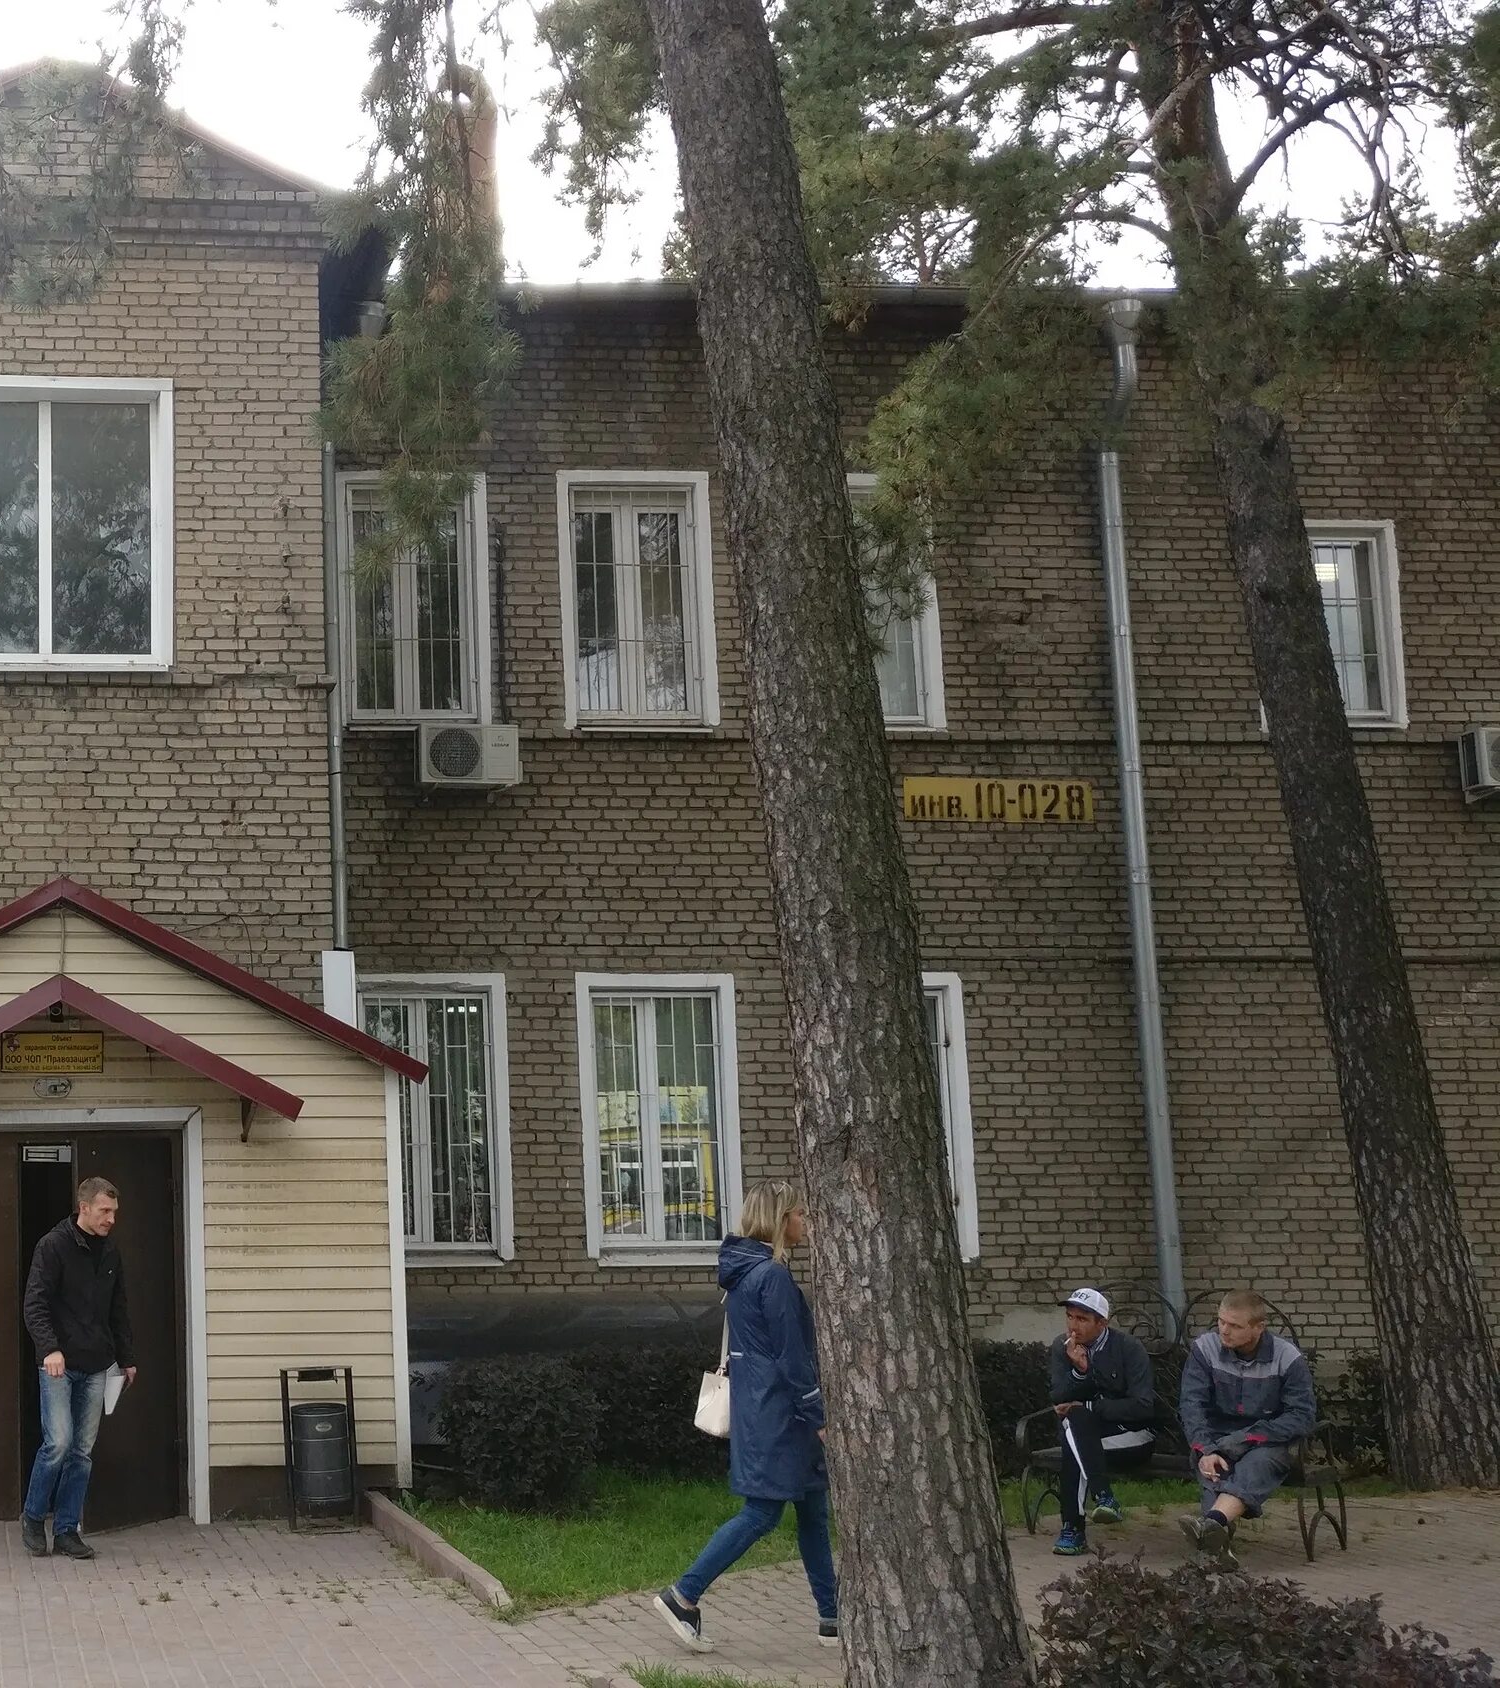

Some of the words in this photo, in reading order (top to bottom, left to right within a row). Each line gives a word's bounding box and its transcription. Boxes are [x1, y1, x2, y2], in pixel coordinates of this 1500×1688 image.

[975, 782, 1085, 820] 10-028
[4, 1054, 22, 1064] ООО
[24, 1054, 41, 1064] ЧОП
